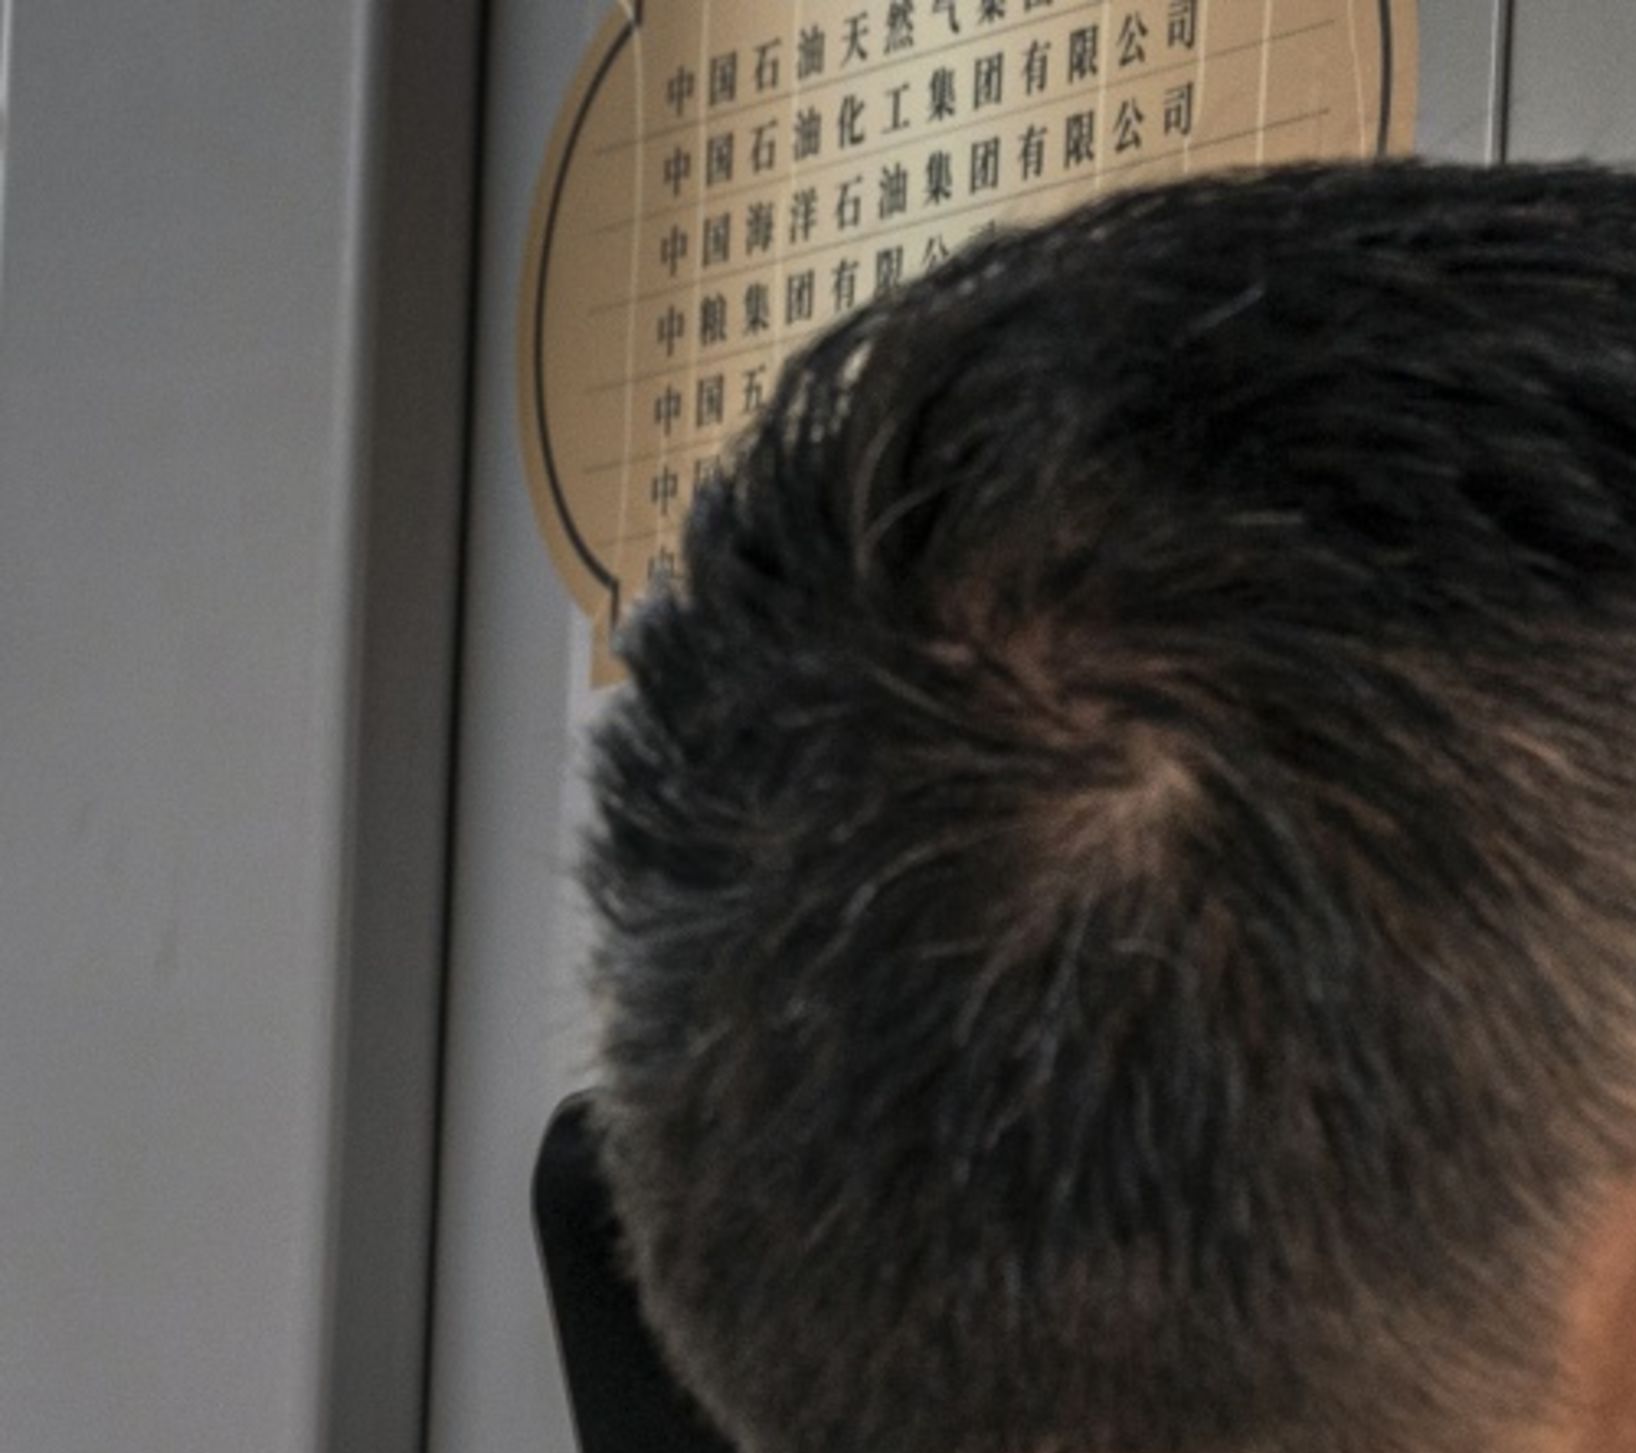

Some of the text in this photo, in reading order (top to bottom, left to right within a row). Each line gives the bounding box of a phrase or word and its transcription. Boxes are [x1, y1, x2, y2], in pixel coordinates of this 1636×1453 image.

[660, 81, 1196, 277] 中国海洋石油集团有限公司
[663, 0, 1199, 197] 中国石油化工集团有限公司
